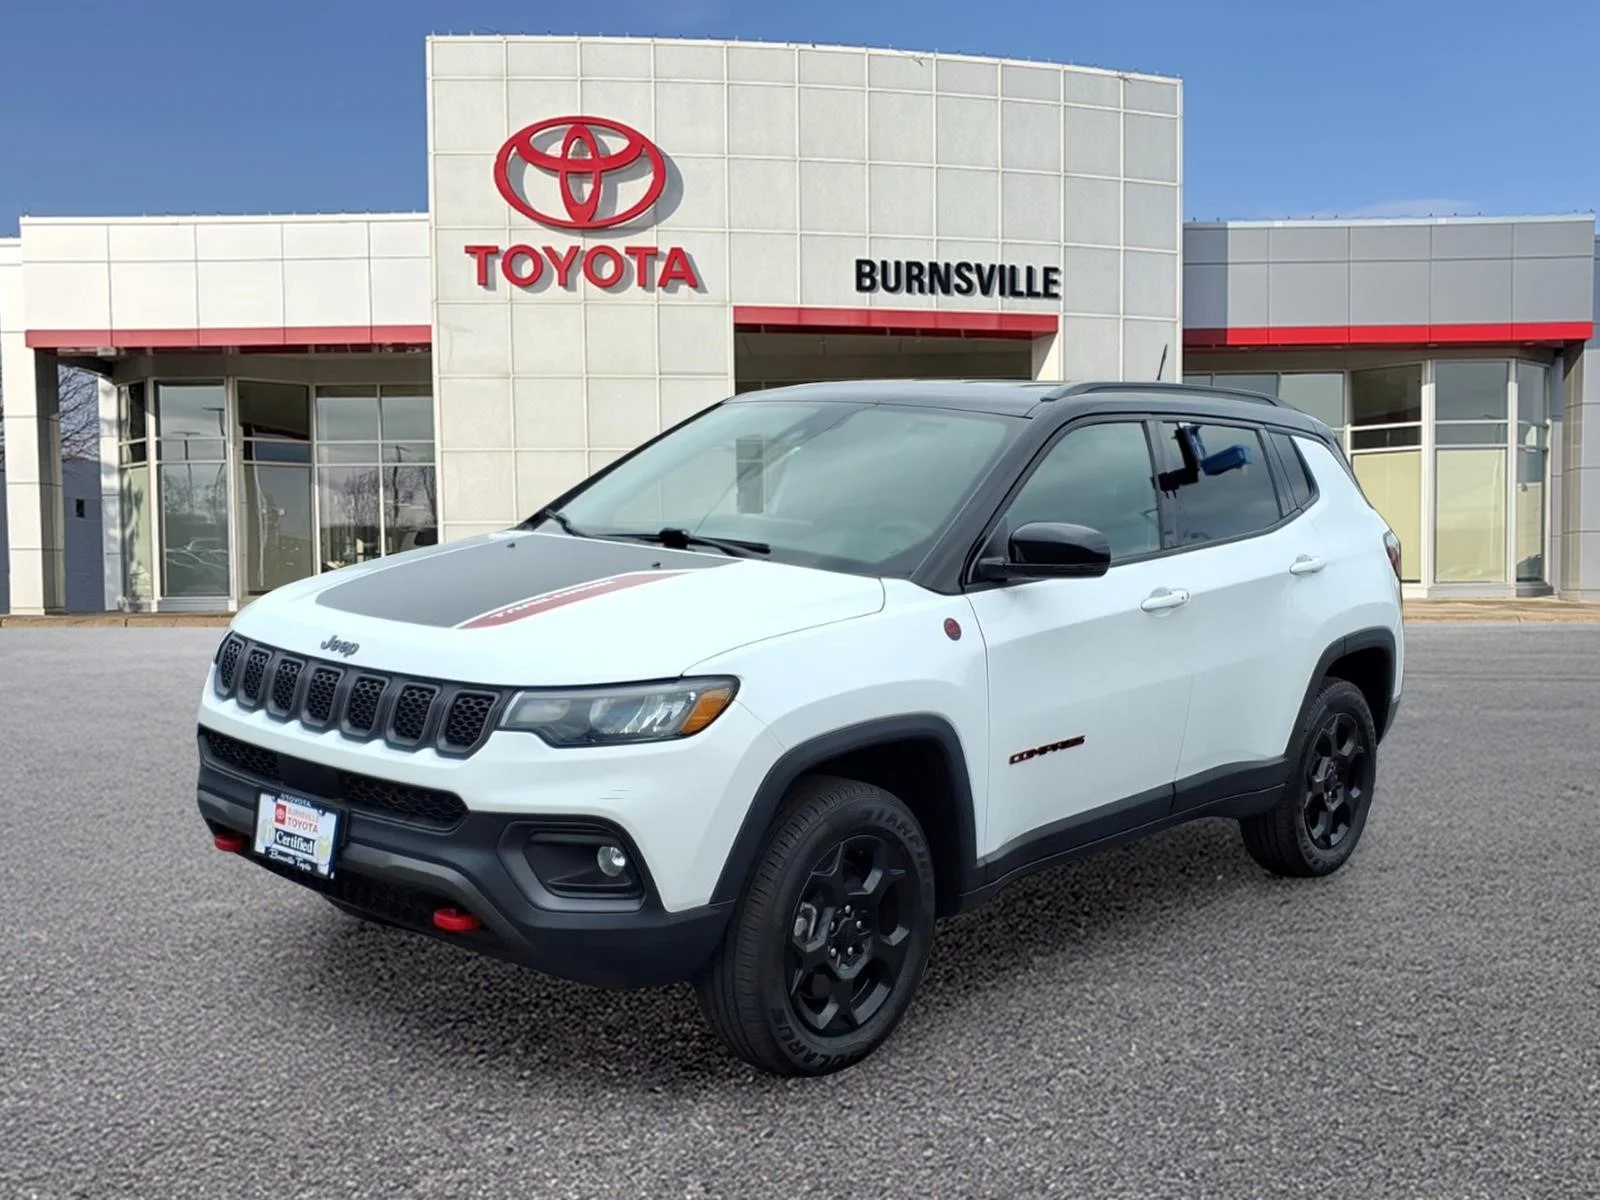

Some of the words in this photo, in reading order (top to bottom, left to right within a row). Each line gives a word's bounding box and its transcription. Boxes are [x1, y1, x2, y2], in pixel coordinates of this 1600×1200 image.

[464, 244, 700, 292] TOYOTA
[854, 258, 1062, 299] BURNSVILLE
[320, 634, 360, 658] Jeep
[288, 816, 319, 833] TOYOTA
[276, 831, 313, 853] Certified
